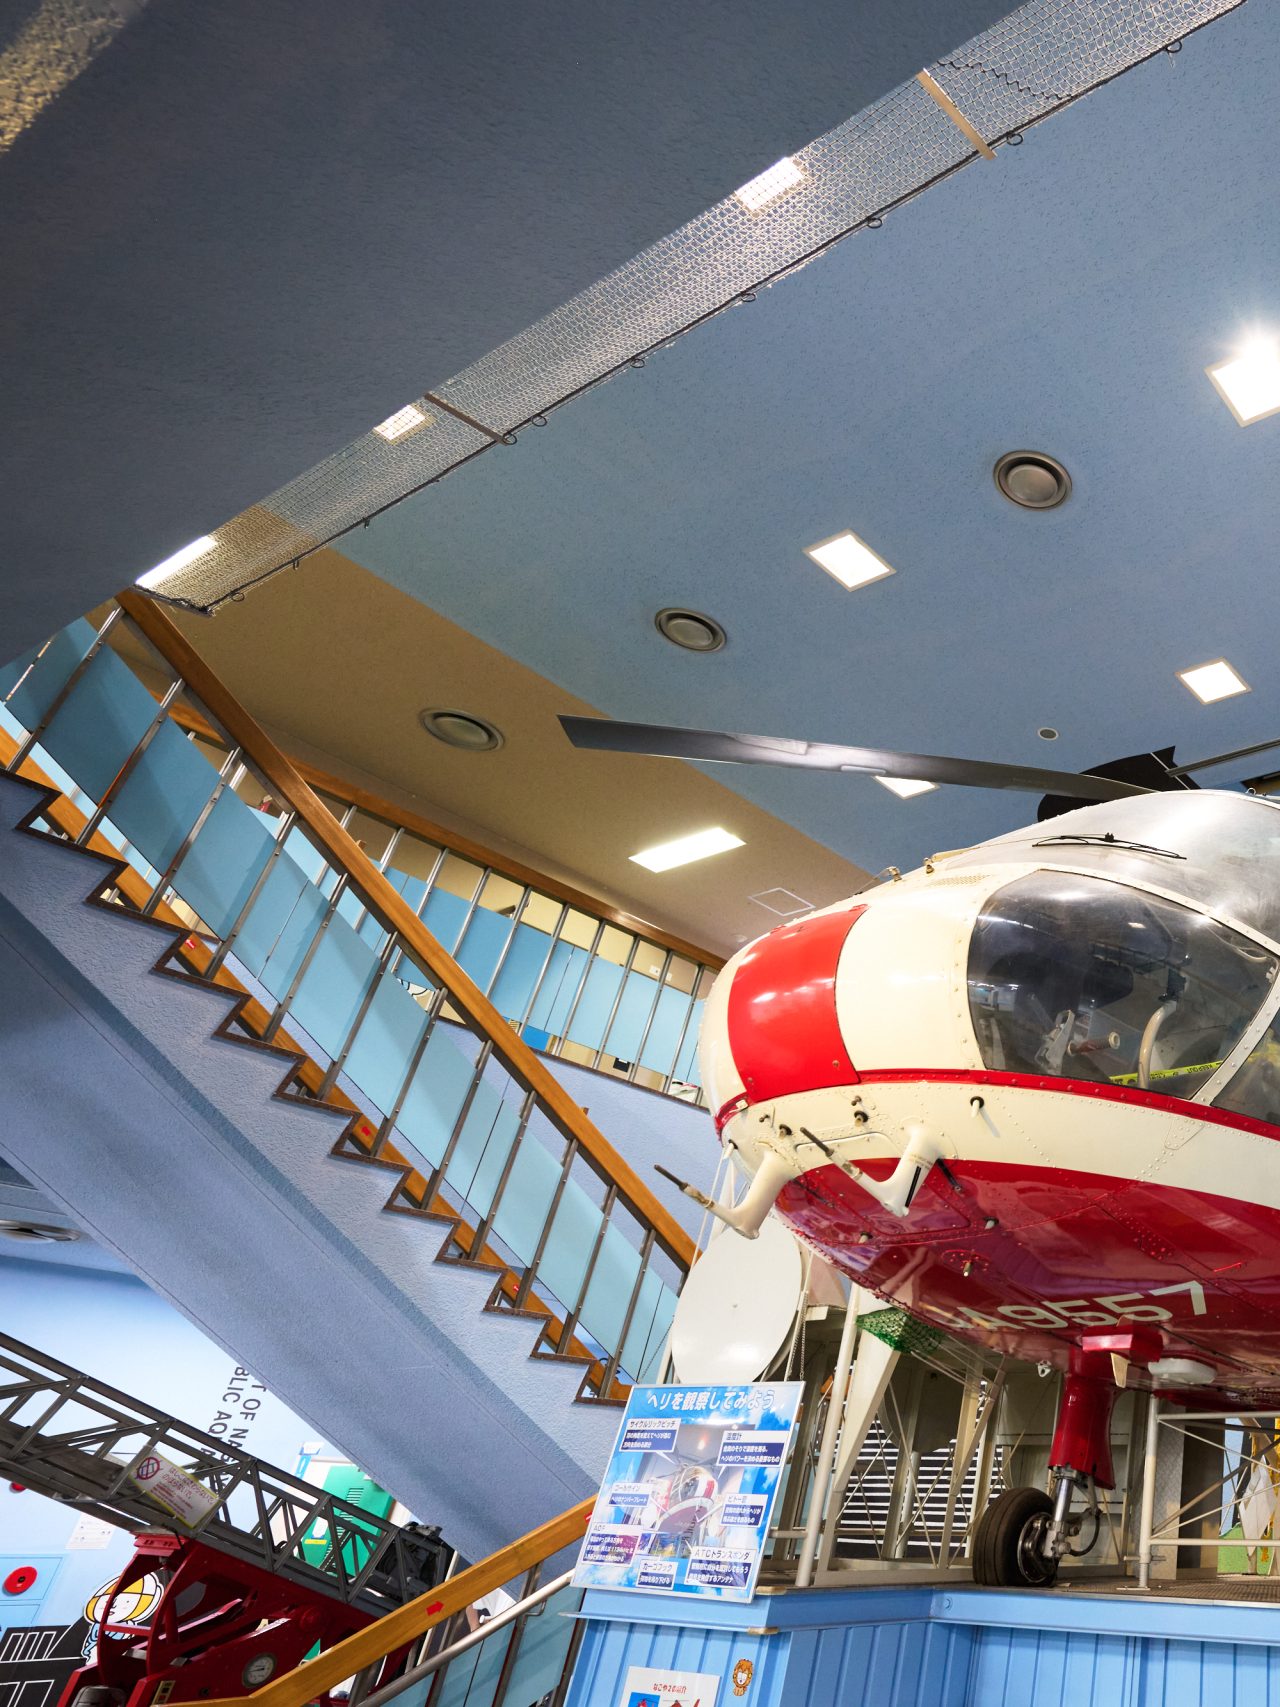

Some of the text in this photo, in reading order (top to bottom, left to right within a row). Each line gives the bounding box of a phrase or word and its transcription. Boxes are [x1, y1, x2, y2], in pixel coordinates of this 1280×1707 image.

[240, 1398, 262, 1421] OF
[648, 1390, 775, 1410] ヘリを観察してみよう
